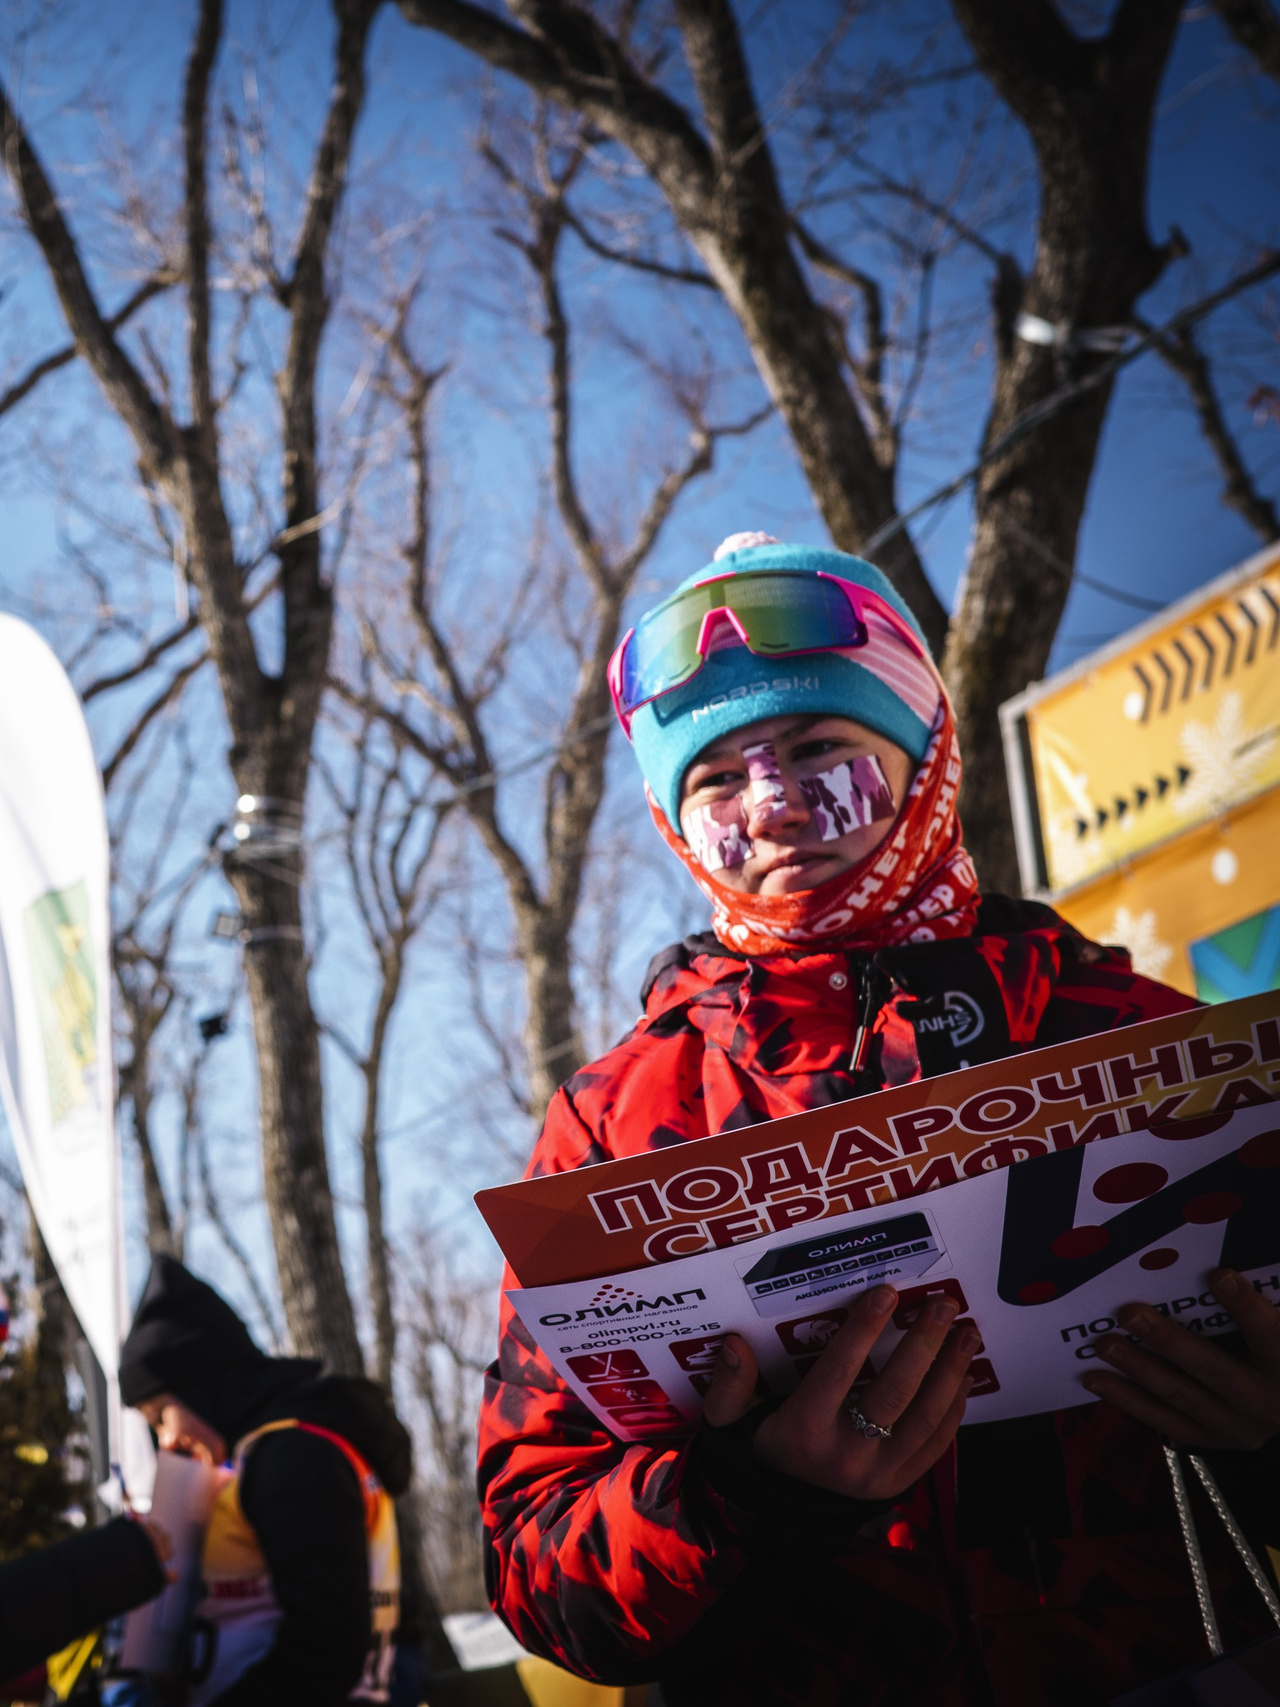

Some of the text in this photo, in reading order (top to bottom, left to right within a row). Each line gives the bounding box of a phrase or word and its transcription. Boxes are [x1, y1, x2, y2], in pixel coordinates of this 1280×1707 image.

[691, 676, 821, 724] NORDSKI
[643, 1068, 1280, 1263] СЕРТИФИКА
[807, 1232, 888, 1259] ОЛИМП
[794, 1267, 902, 1302] АКЦИОННАЯ КАРТА
[538, 1287, 708, 1327] ОЛИМП
[557, 1303, 700, 1332] сеть спортивных магазинов
[559, 1321, 722, 1355] 8-800-100-12-15
[587, 1317, 682, 1340] olimpvl.ru
